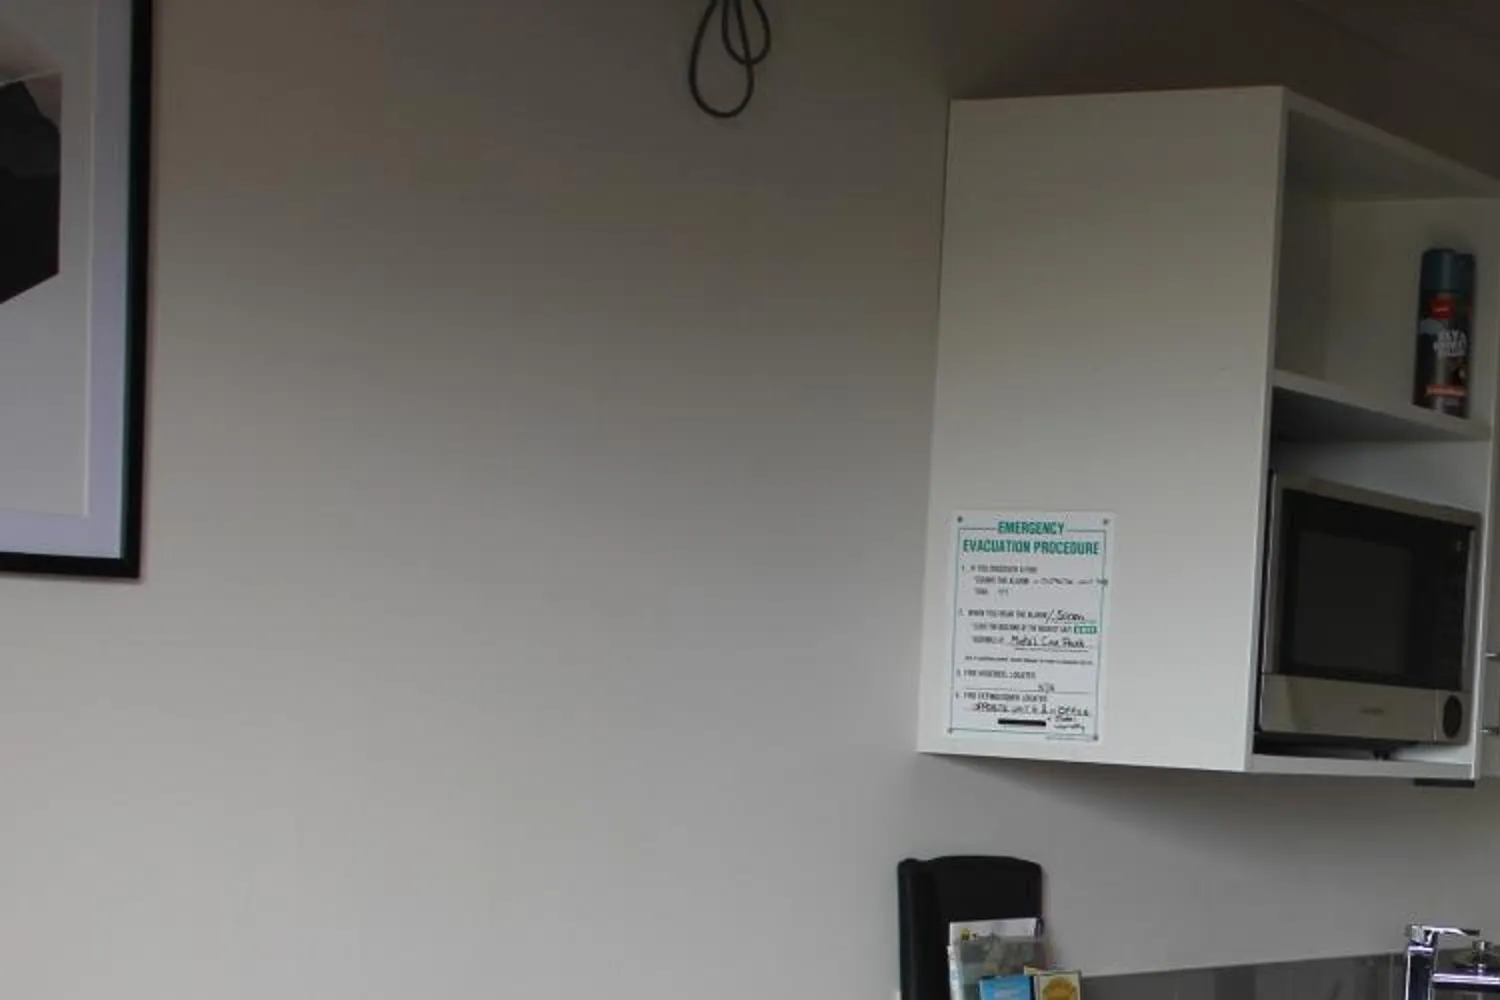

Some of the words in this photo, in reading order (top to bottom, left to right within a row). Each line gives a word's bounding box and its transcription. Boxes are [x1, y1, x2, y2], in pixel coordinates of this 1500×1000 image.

[997, 521, 1065, 535] EMERGENCY
[962, 539, 1031, 554] EVACUATION
[1033, 541, 1100, 555] PROCEDURE
